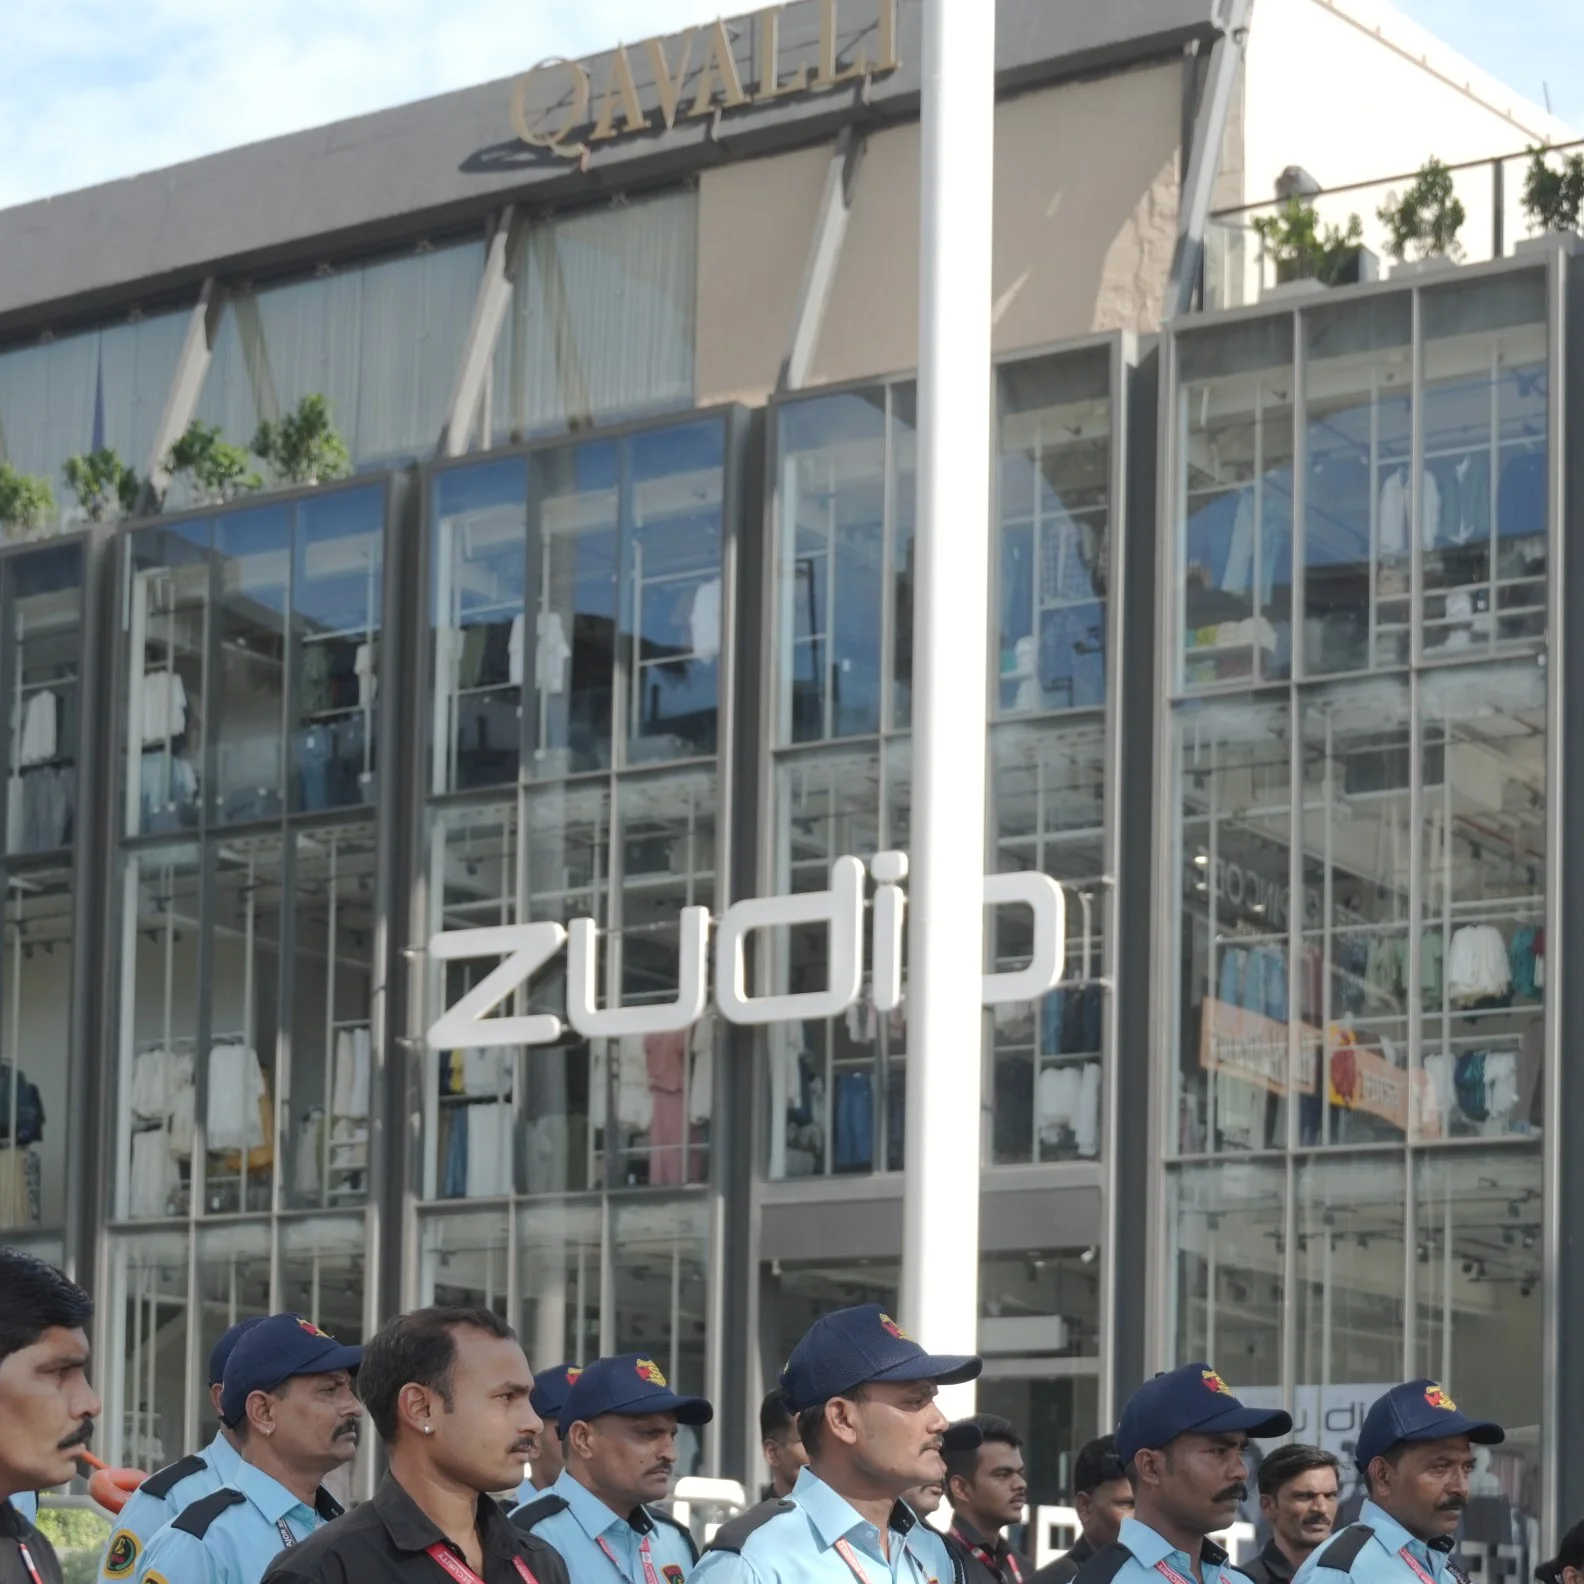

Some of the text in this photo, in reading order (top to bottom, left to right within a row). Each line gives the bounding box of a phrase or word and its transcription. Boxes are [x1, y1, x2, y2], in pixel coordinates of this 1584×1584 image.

[511, 0, 902, 158] QAVALLI
[426, 850, 1065, 1050] zudio
[280, 1528, 293, 1548] AJOR
[438, 1553, 472, 1584] SECURITY
